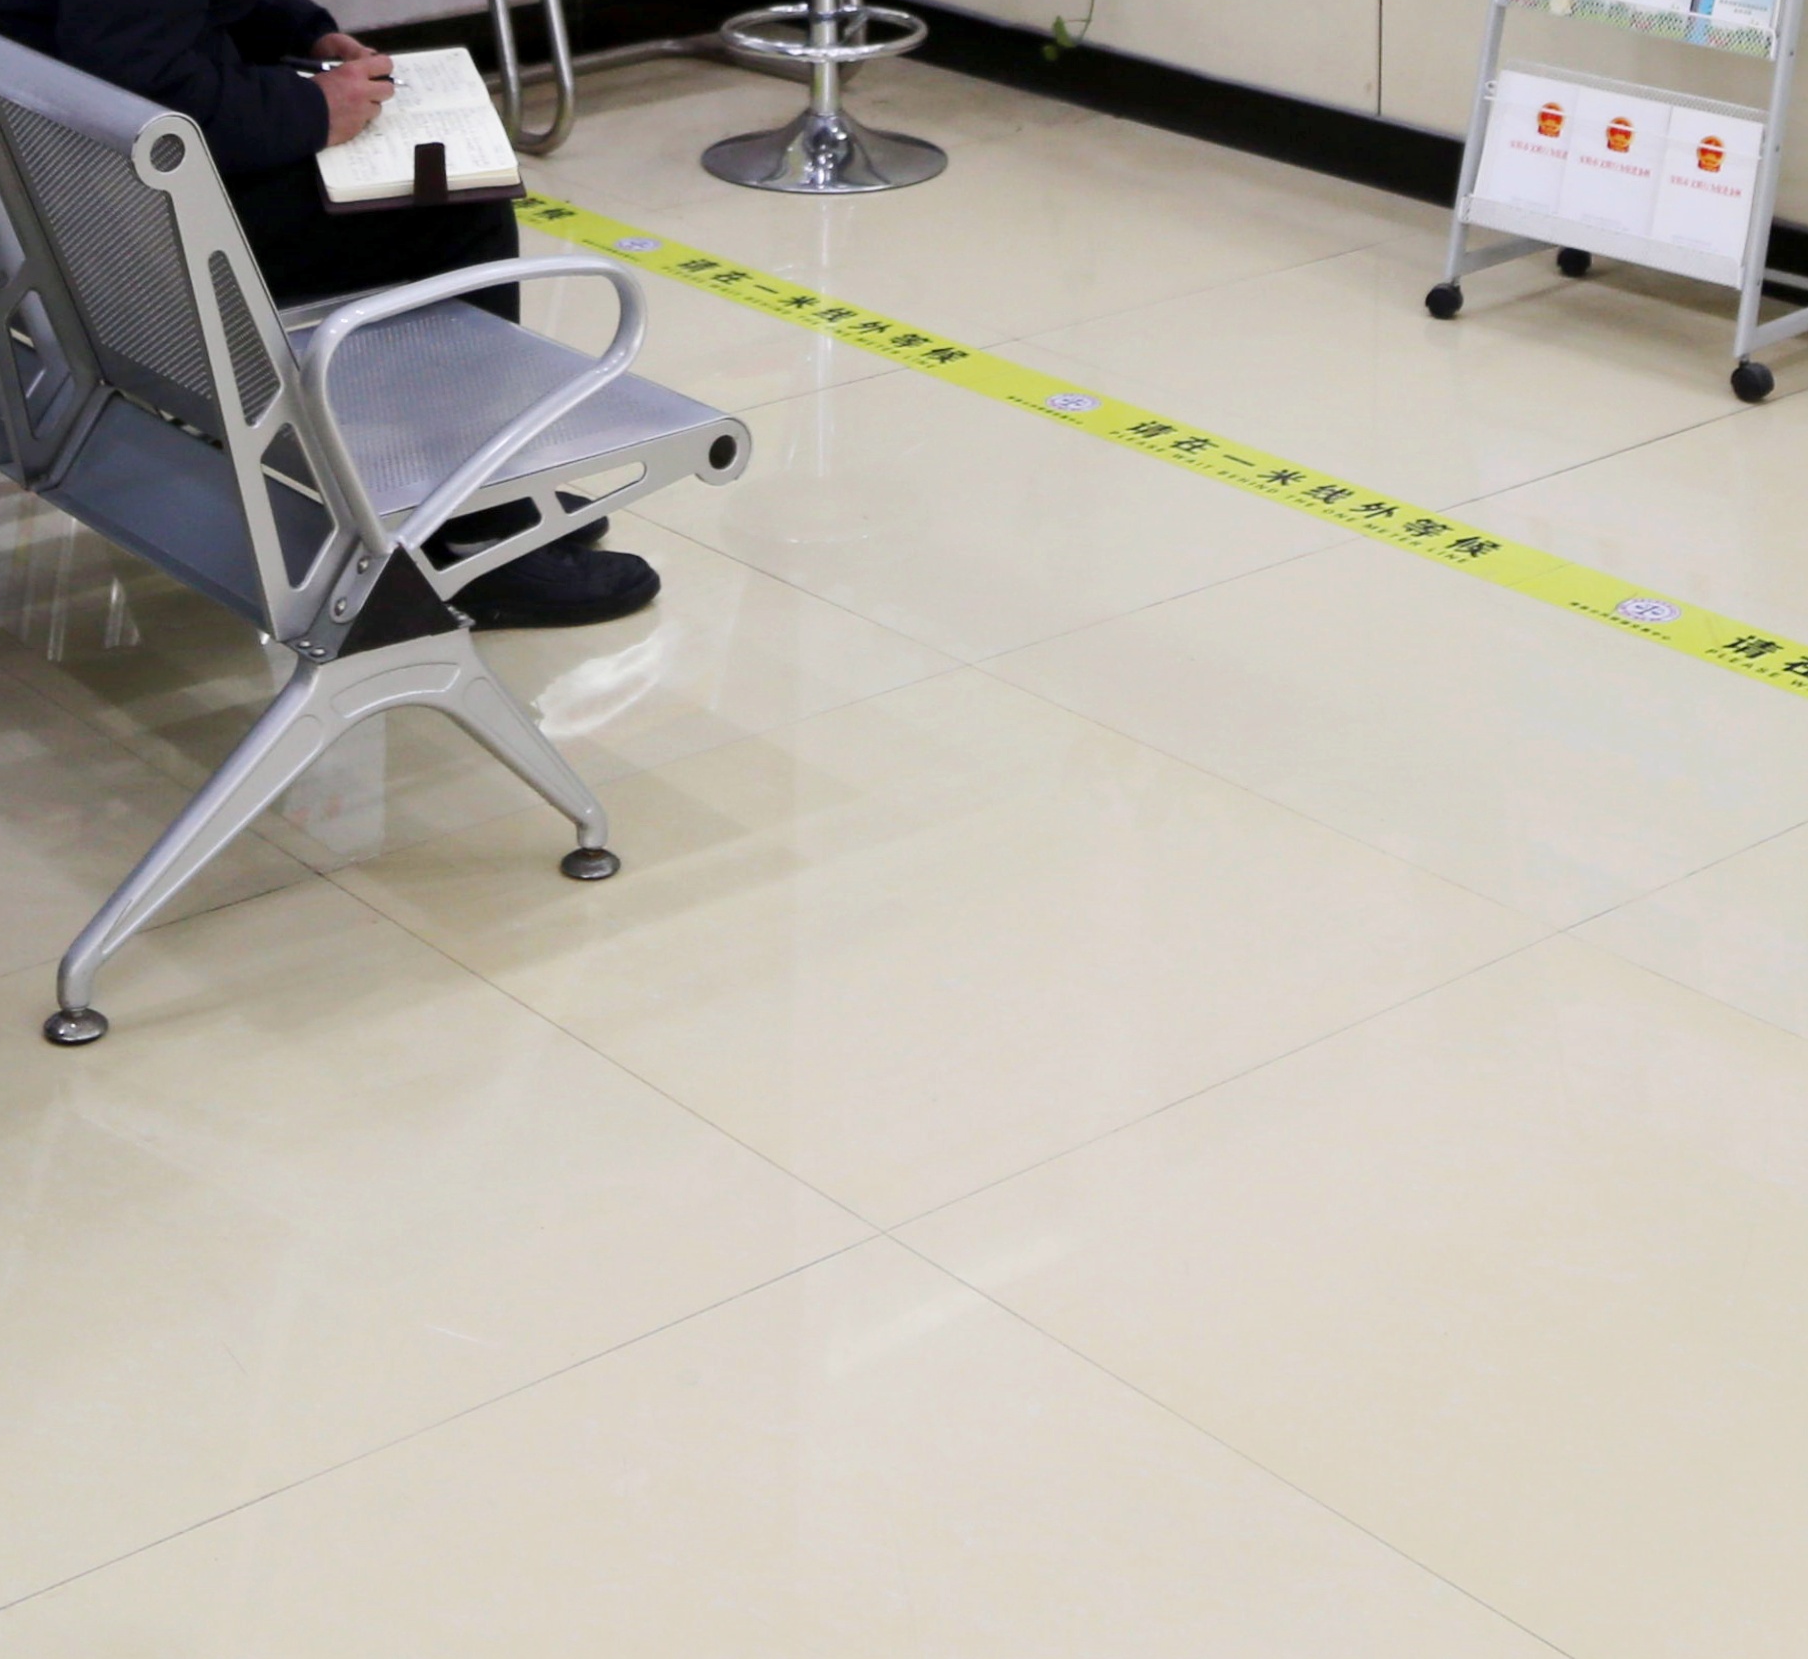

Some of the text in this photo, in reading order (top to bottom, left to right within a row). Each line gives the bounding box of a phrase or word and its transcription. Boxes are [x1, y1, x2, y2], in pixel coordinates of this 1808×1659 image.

[678, 259, 968, 364] 请在一米线外等候
[1126, 421, 1500, 557] 请在一米线外等候
[1705, 649, 1780, 677] PLEASE
